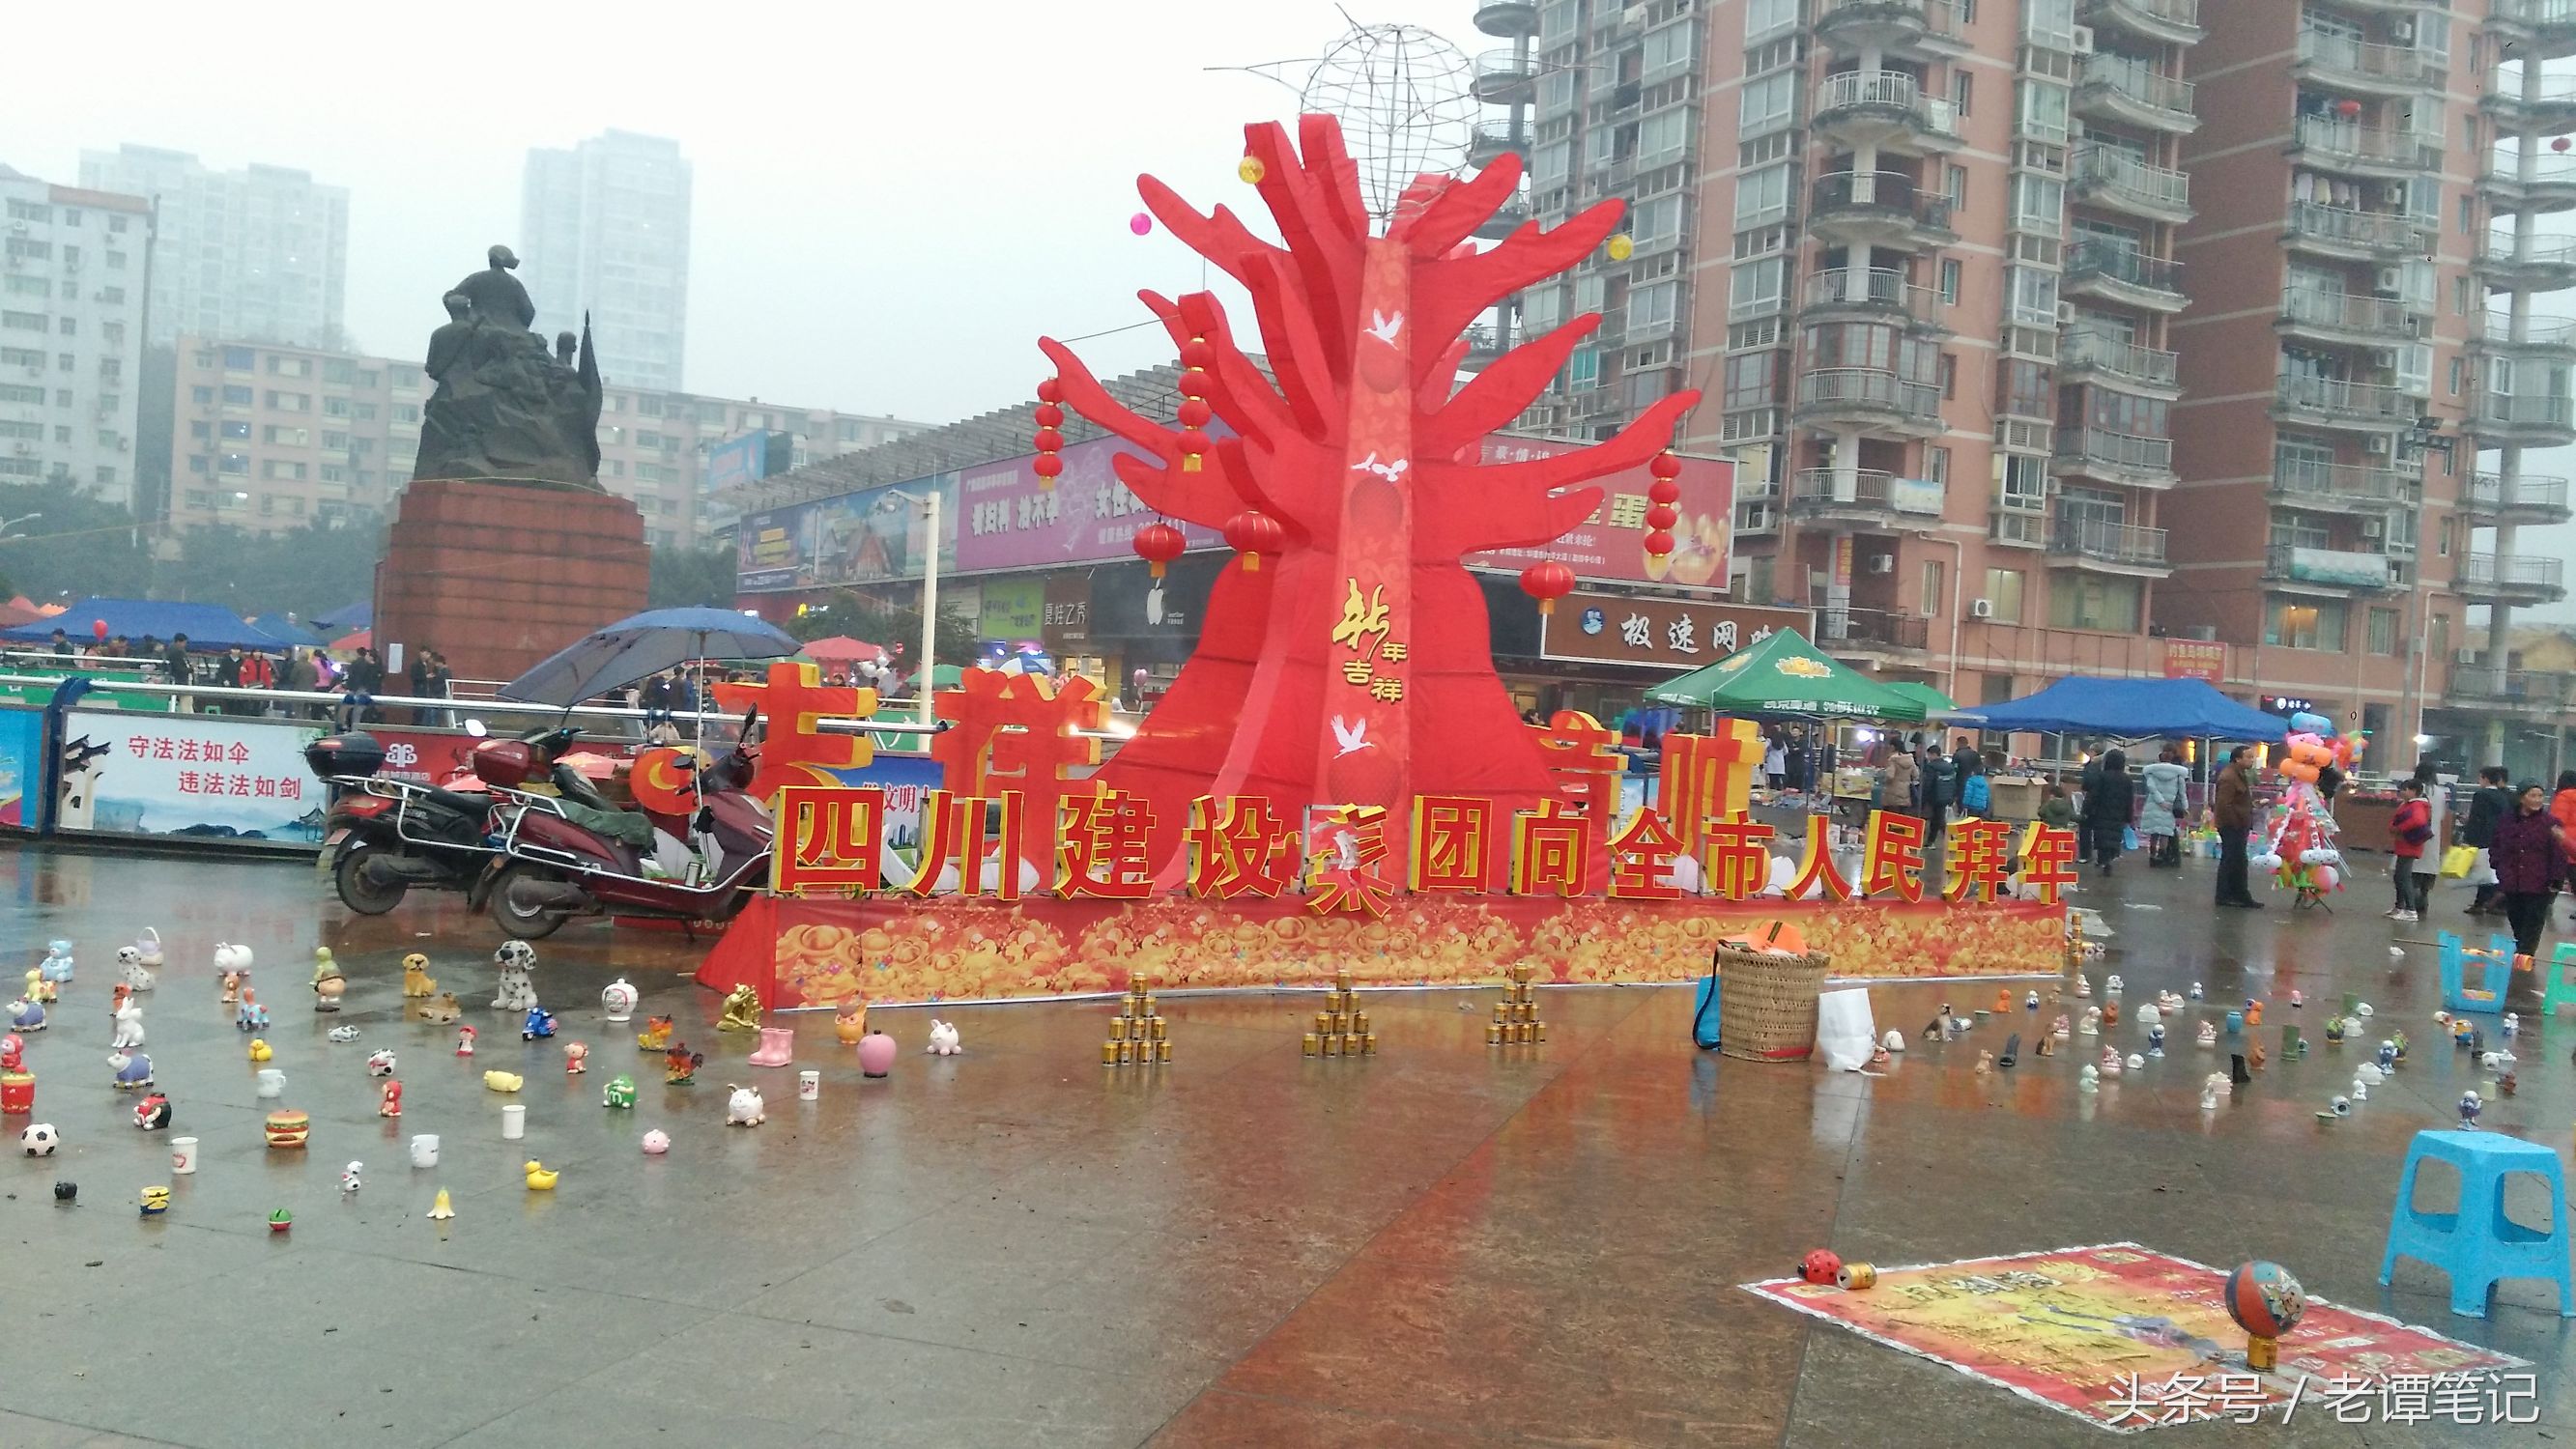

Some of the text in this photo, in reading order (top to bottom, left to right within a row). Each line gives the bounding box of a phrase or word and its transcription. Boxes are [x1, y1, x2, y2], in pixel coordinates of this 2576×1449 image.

[129, 735, 249, 765] 守法法如伞
[179, 771, 302, 800] 违法法如剑
[776, 784, 2080, 919] 四川建设集团向全市人民拜年
